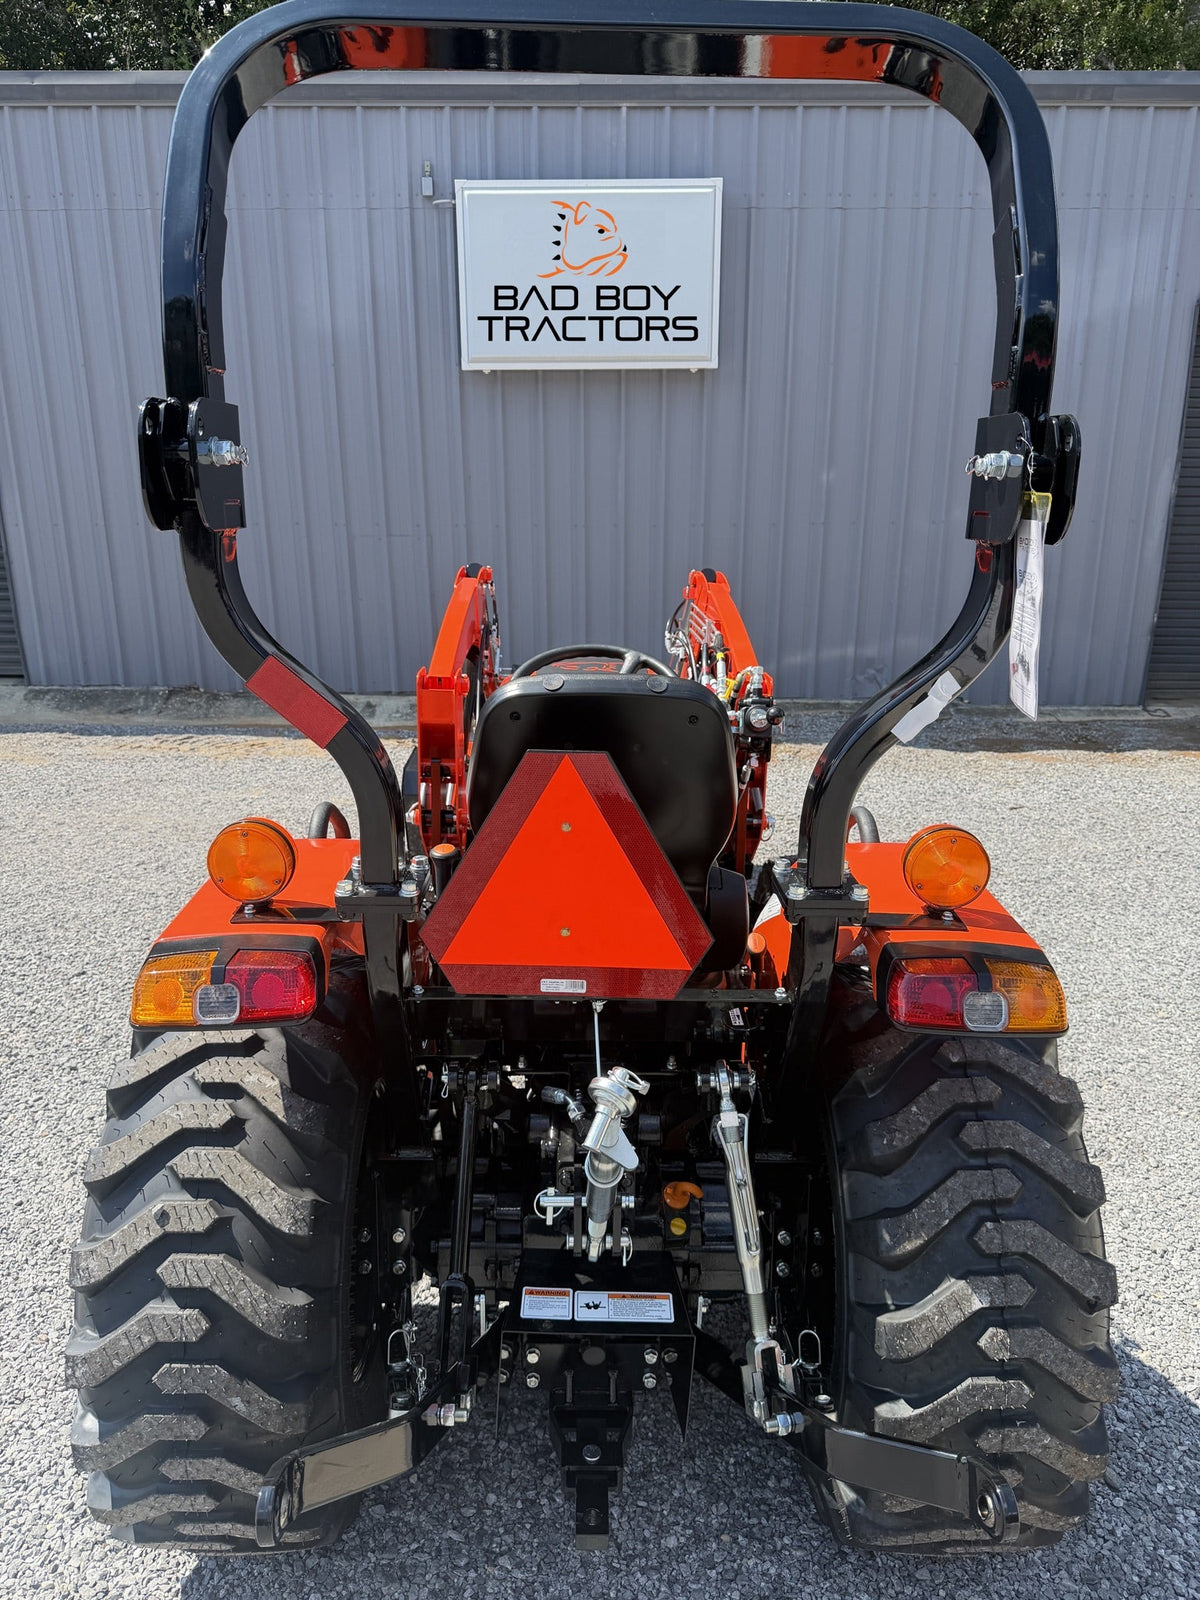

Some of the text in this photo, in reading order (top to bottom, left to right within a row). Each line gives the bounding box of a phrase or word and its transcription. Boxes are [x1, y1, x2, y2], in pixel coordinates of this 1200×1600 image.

[493, 285, 682, 311] BAD BOY
[477, 315, 699, 342] TRACTORS
